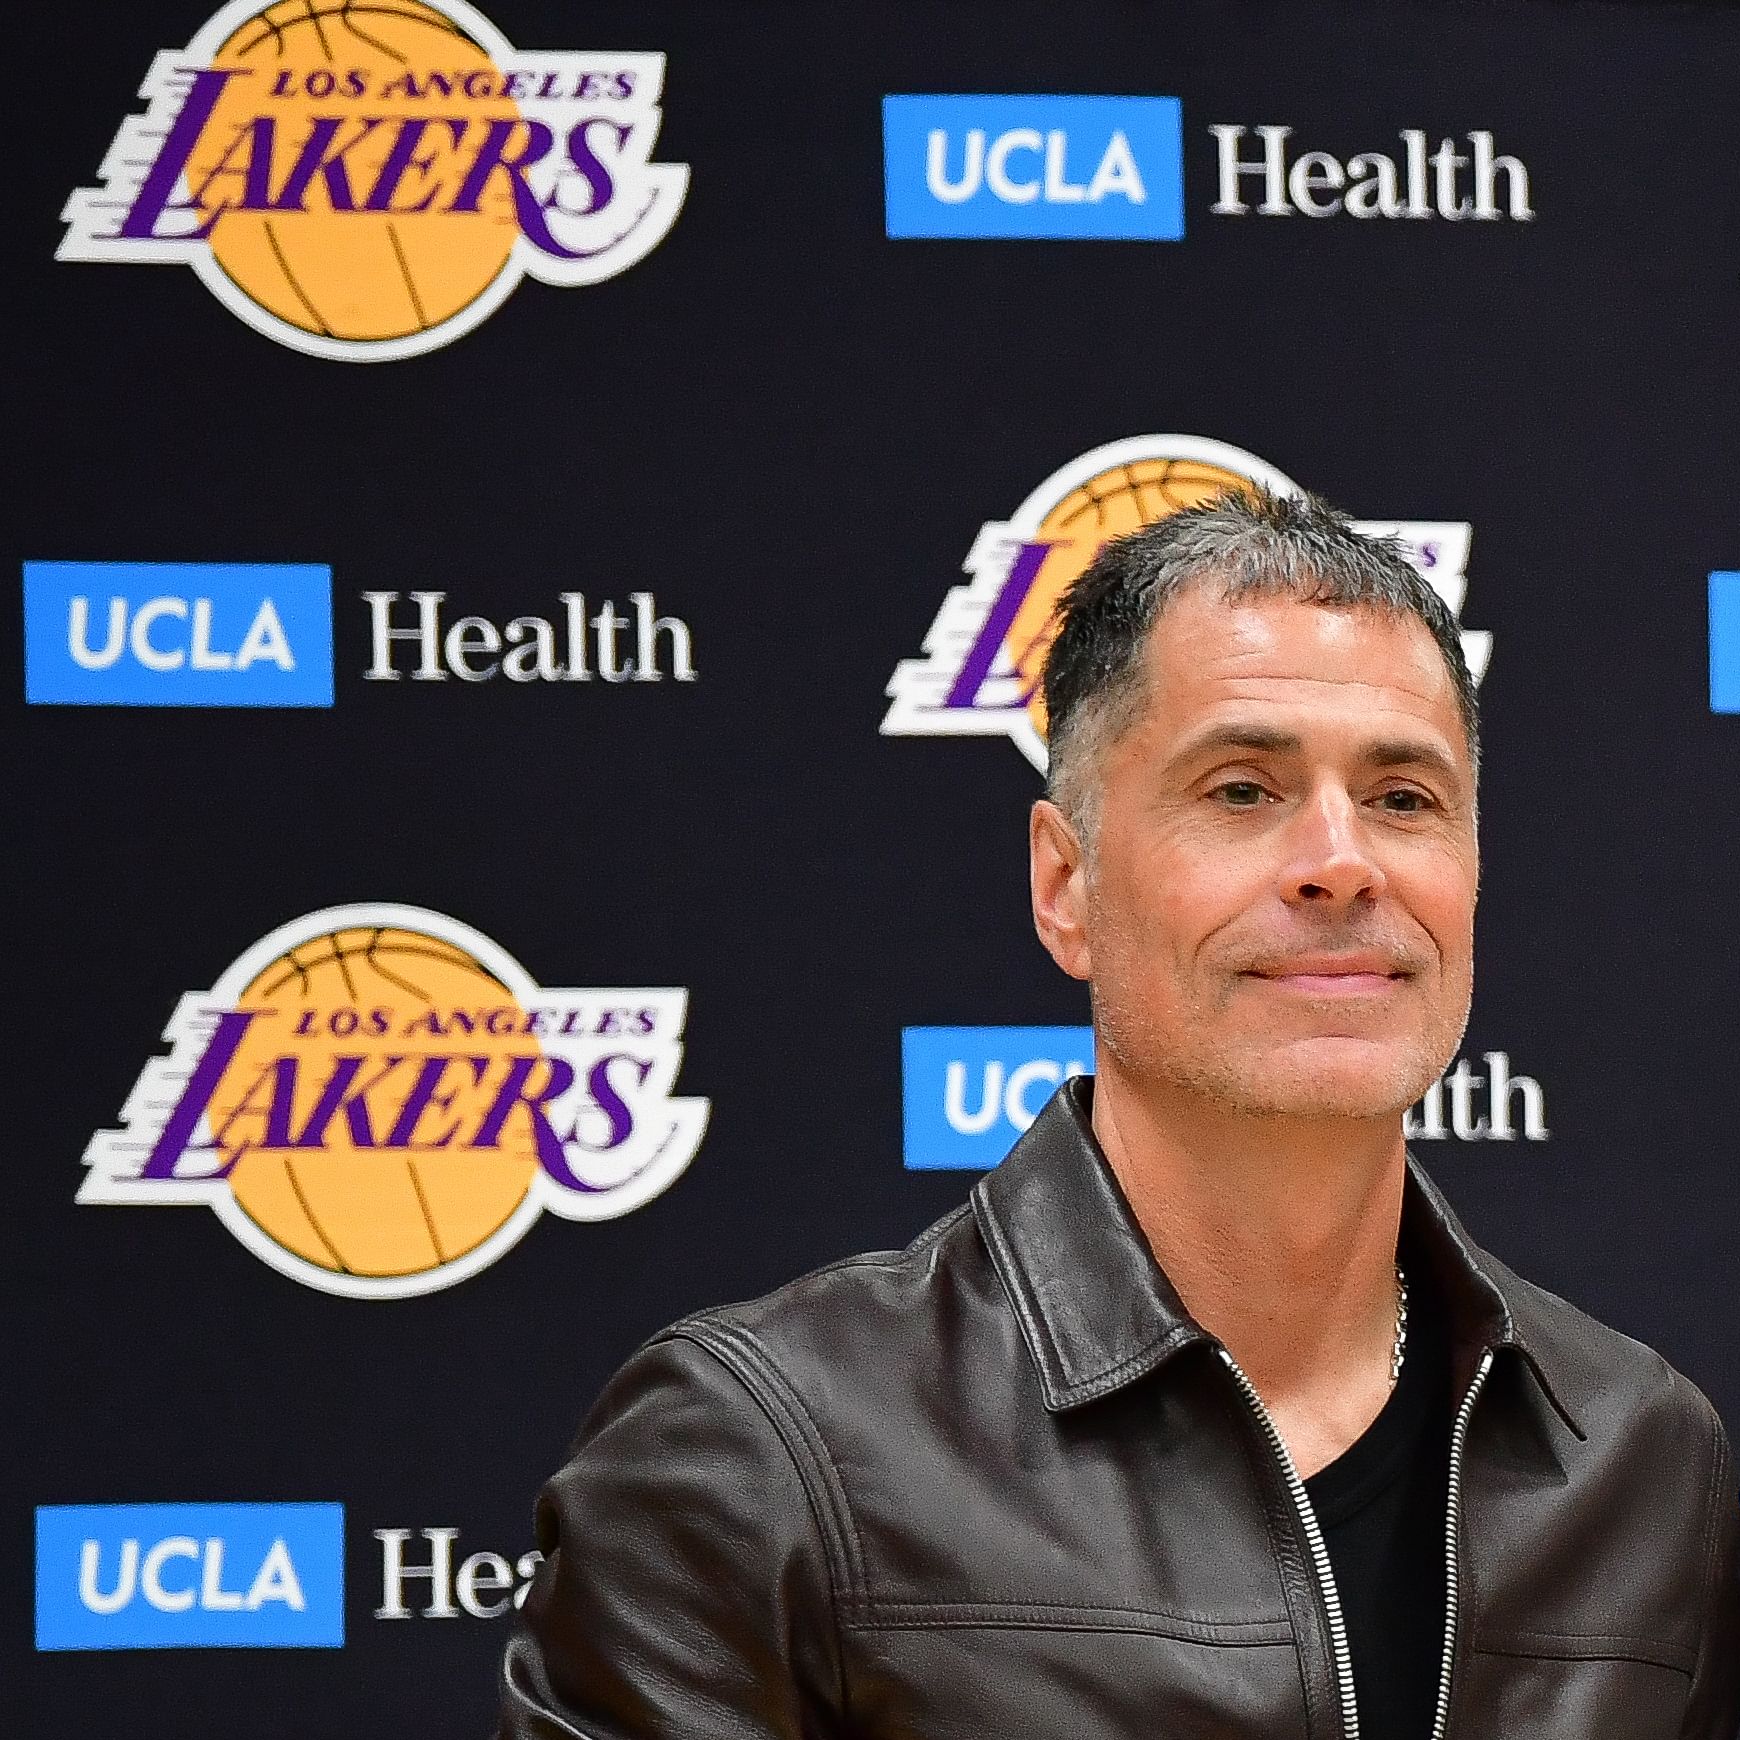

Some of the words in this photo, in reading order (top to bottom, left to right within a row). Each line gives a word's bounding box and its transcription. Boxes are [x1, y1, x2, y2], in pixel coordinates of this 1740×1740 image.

[271, 68, 366, 99] LOS
[381, 69, 638, 100] ANGELES
[90, 66, 660, 259] LAKERS
[925, 128, 1147, 204] UCLA
[1208, 124, 1536, 221] Health
[67, 596, 295, 671] UCLA
[362, 591, 698, 682] Health
[294, 1008, 389, 1036] LOS
[402, 1008, 658, 1037] ANGELES
[111, 1009, 678, 1193] LAKERS
[944, 1058, 1086, 1136] UC
[1402, 1051, 1551, 1142] lth
[78, 1534, 305, 1614] UCLA
